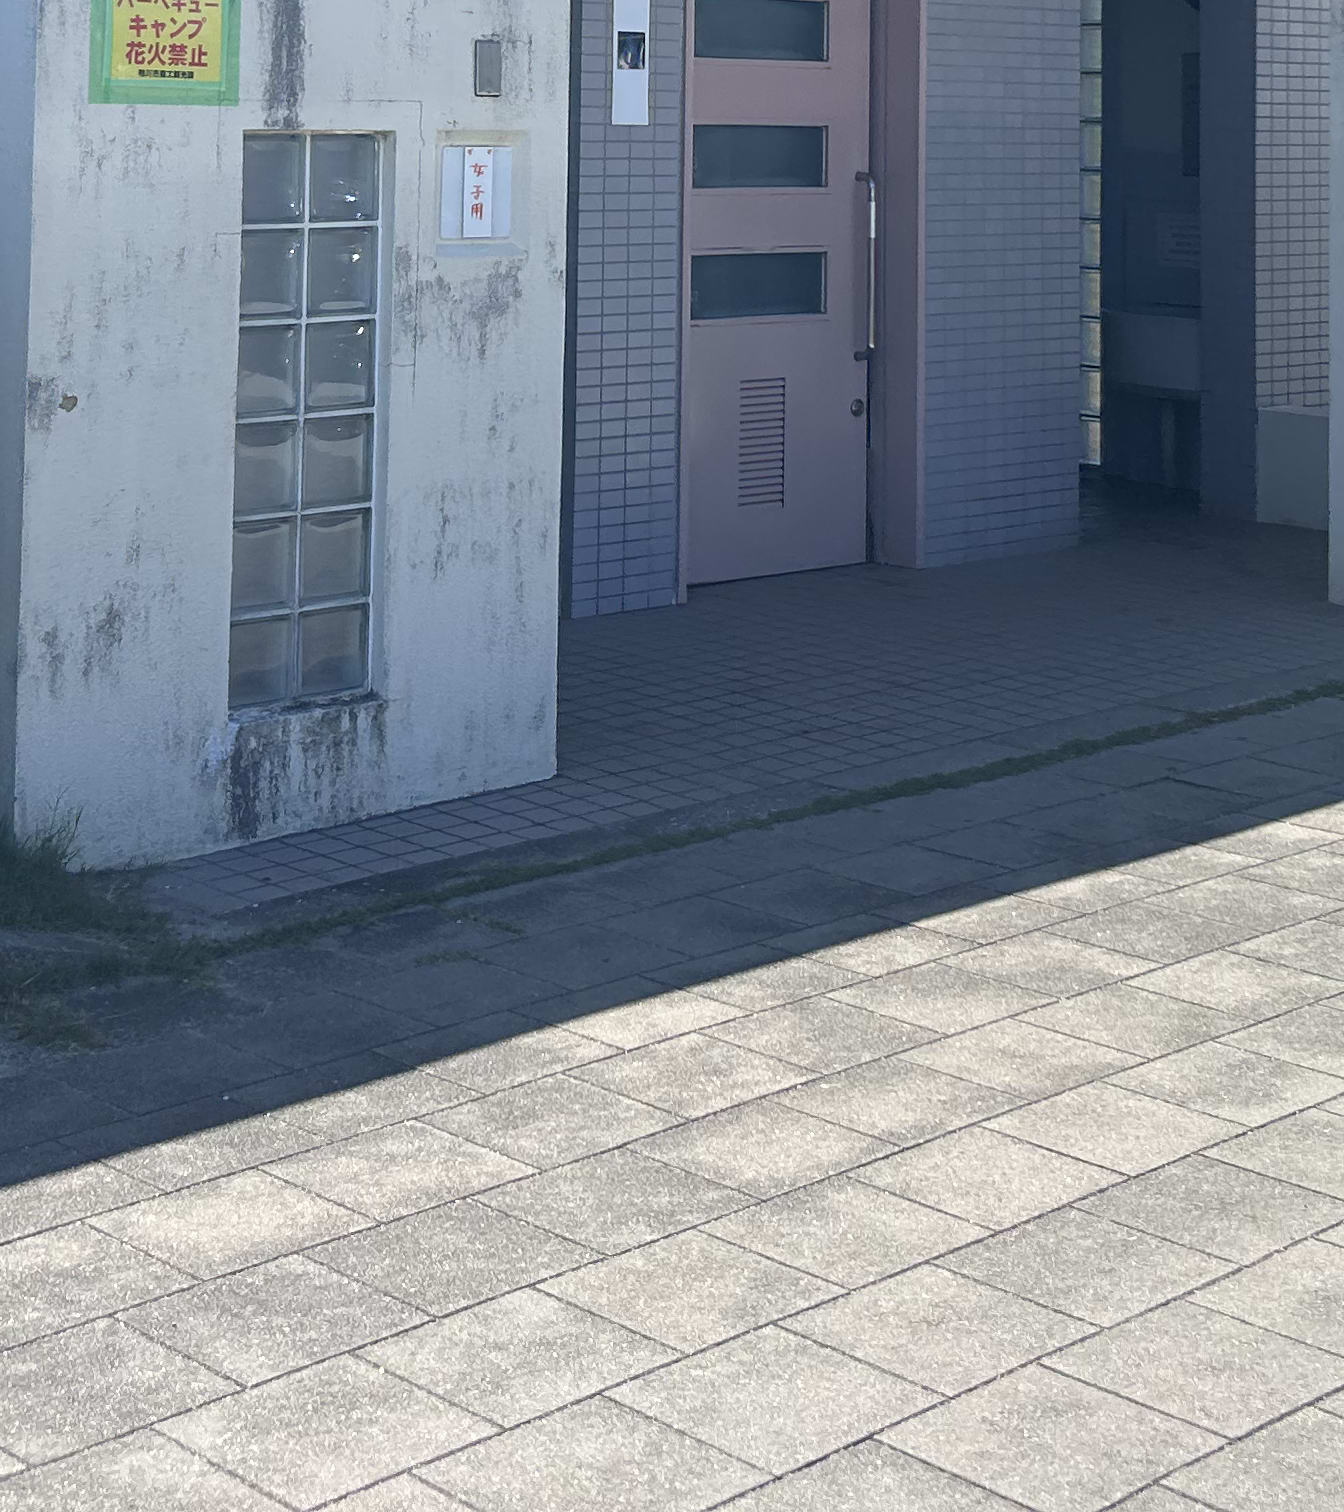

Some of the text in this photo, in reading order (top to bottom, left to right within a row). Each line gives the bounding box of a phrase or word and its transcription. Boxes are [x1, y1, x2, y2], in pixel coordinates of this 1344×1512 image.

[129, 14, 207, 39] キャンプ
[125, 40, 208, 67] 花火禁止
[469, 163, 488, 220] 女子用
